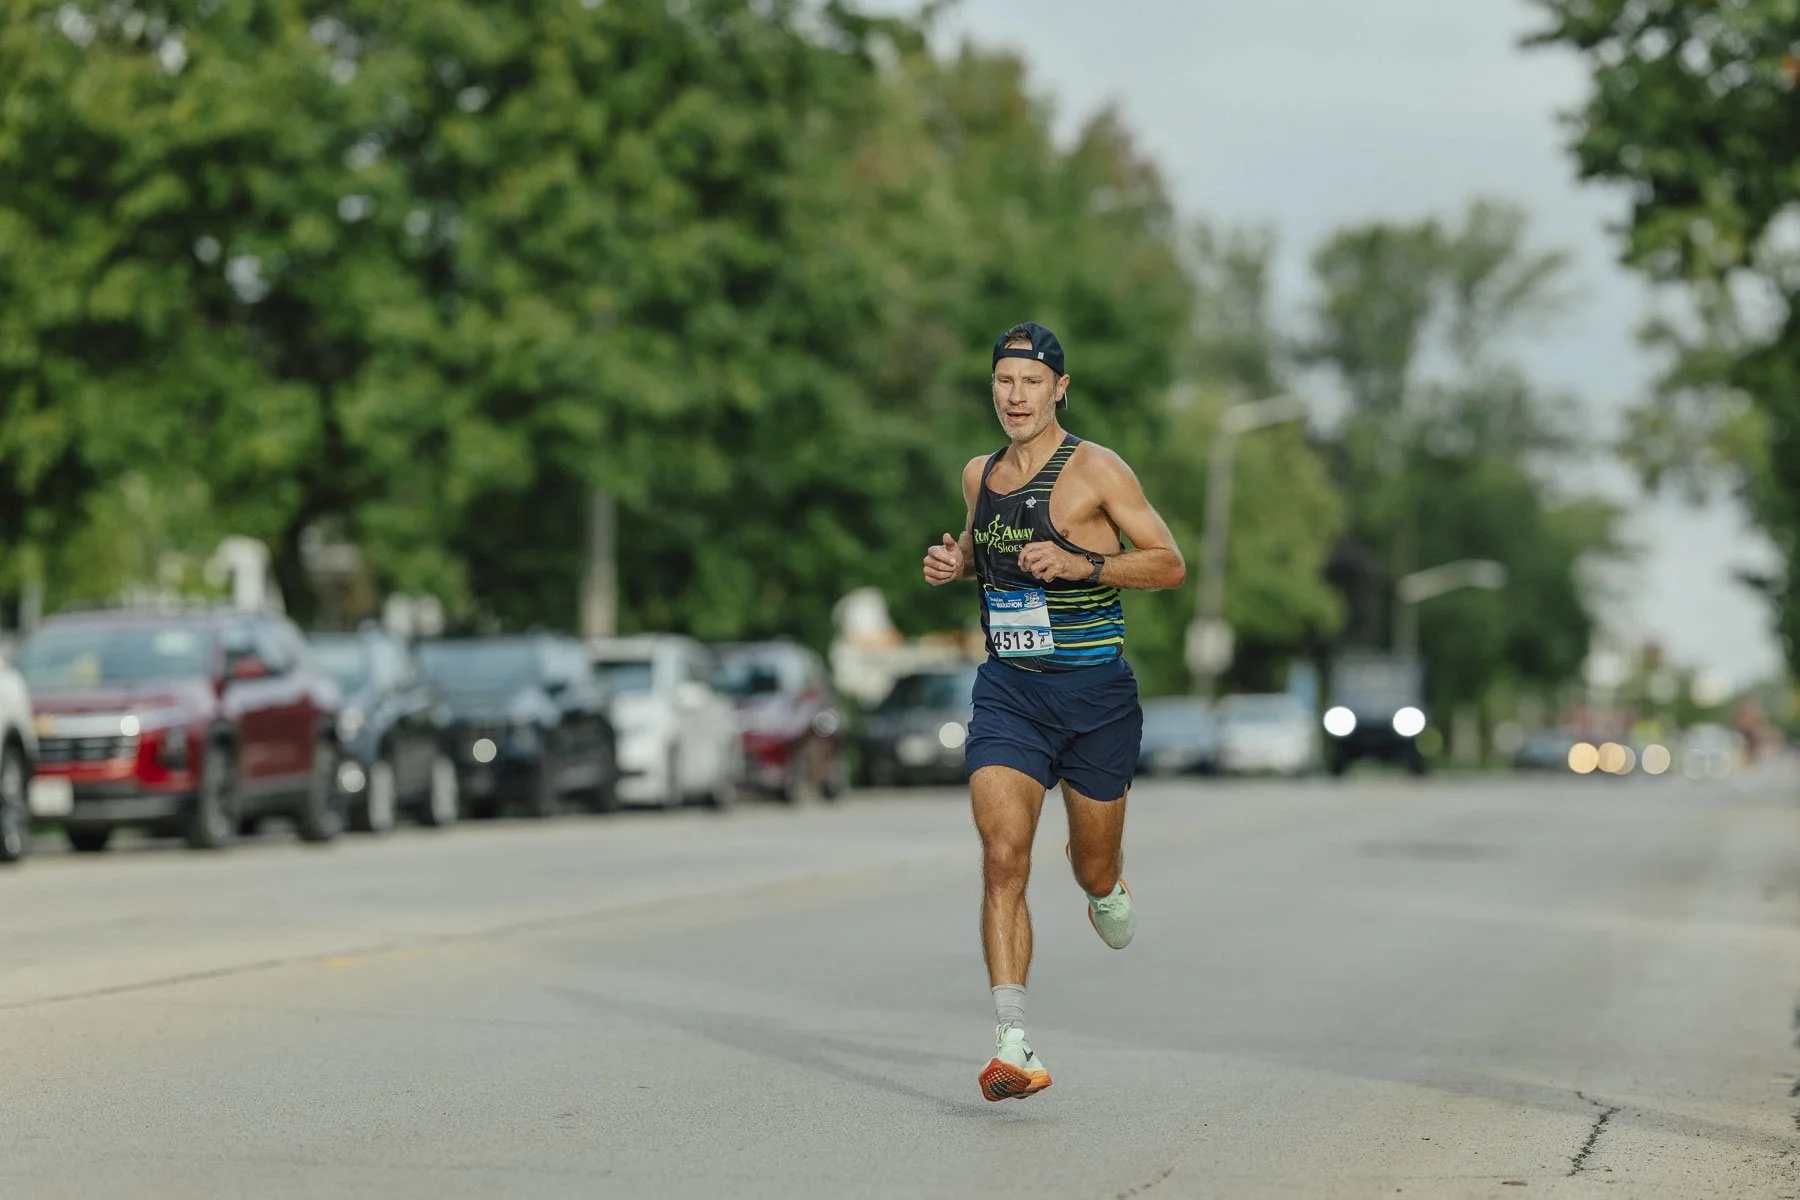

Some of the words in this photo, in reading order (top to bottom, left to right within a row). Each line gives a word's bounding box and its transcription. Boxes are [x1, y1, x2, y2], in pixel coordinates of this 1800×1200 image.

[1002, 526, 1034, 541] AWAY
[998, 542, 1023, 554] SHOES
[994, 630, 1034, 650] 4513
